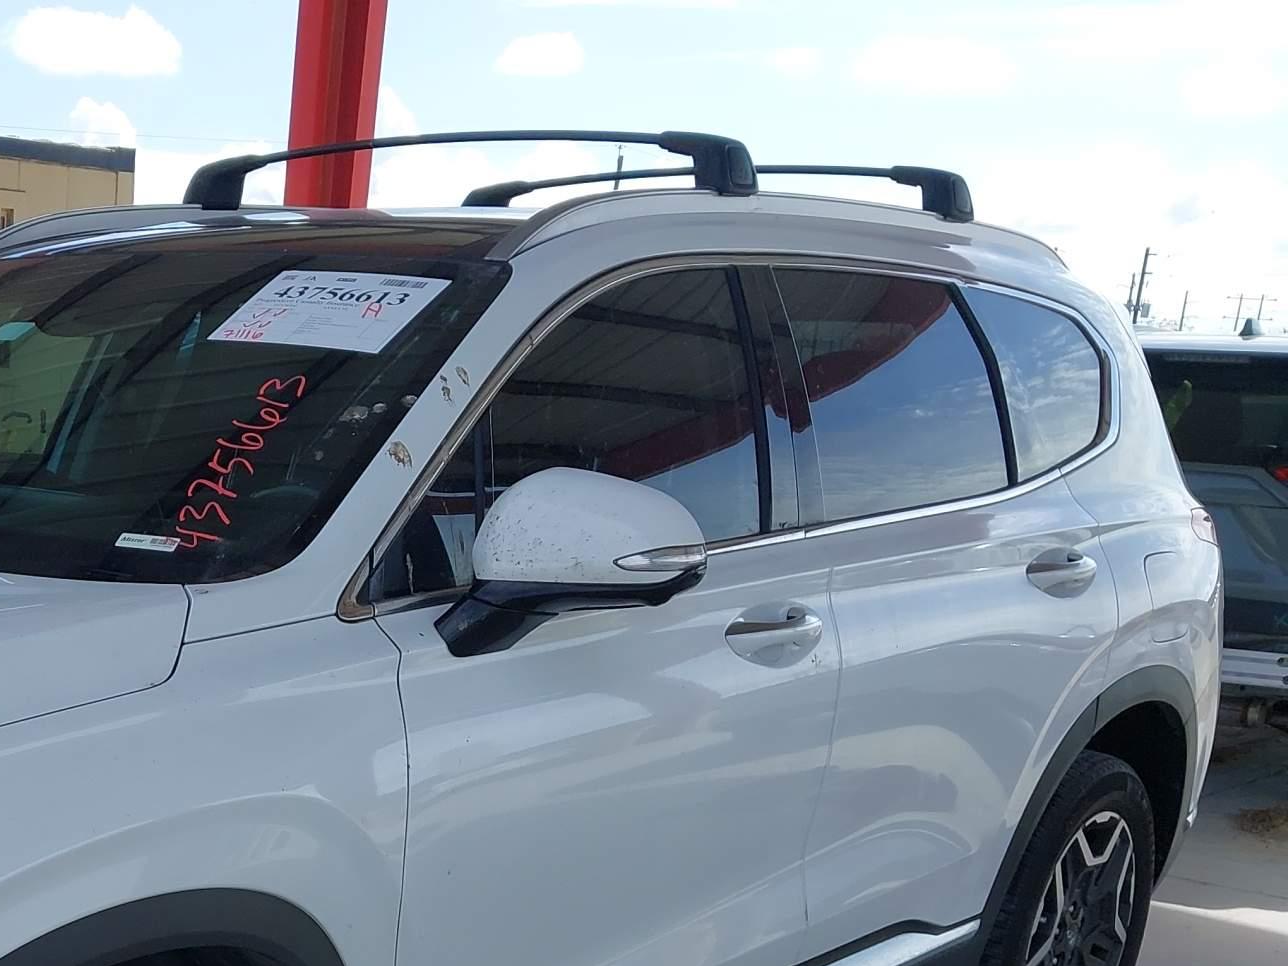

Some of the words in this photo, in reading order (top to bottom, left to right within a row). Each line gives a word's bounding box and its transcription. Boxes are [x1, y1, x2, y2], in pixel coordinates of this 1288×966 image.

[274, 284, 411, 306] 43756613
[361, 301, 384, 319] A
[175, 375, 306, 549] 43756613
